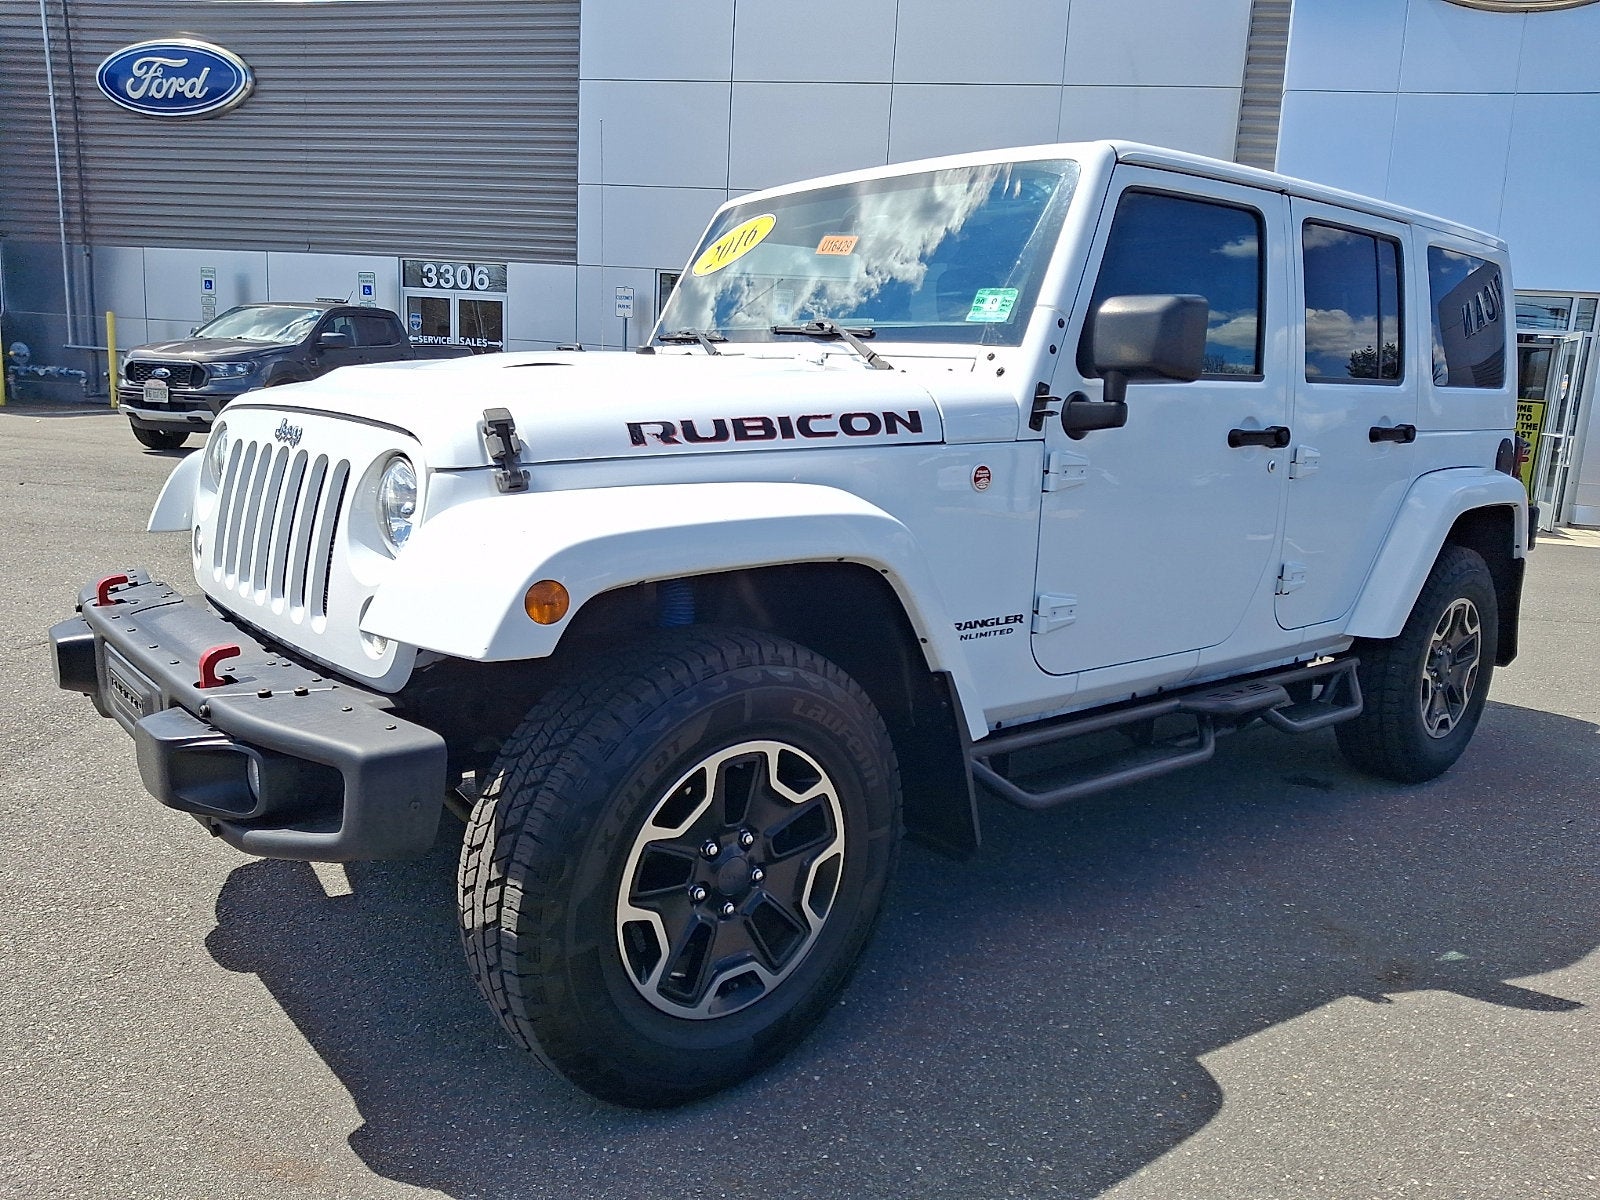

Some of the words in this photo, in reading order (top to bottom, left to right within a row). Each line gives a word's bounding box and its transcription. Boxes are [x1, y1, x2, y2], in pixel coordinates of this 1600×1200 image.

[126, 56, 211, 100] Ford
[704, 225, 758, 270] 2016
[821, 240, 853, 253] U16429
[422, 263, 490, 291] 3306
[418, 335, 452, 345] SERVICE
[459, 336, 488, 348] SALES
[1516, 404, 1533, 413] ME
[1516, 413, 1533, 422] TO
[275, 417, 303, 449] Jeep
[625, 409, 924, 448] RUBICON
[1521, 422, 1539, 431] THE
